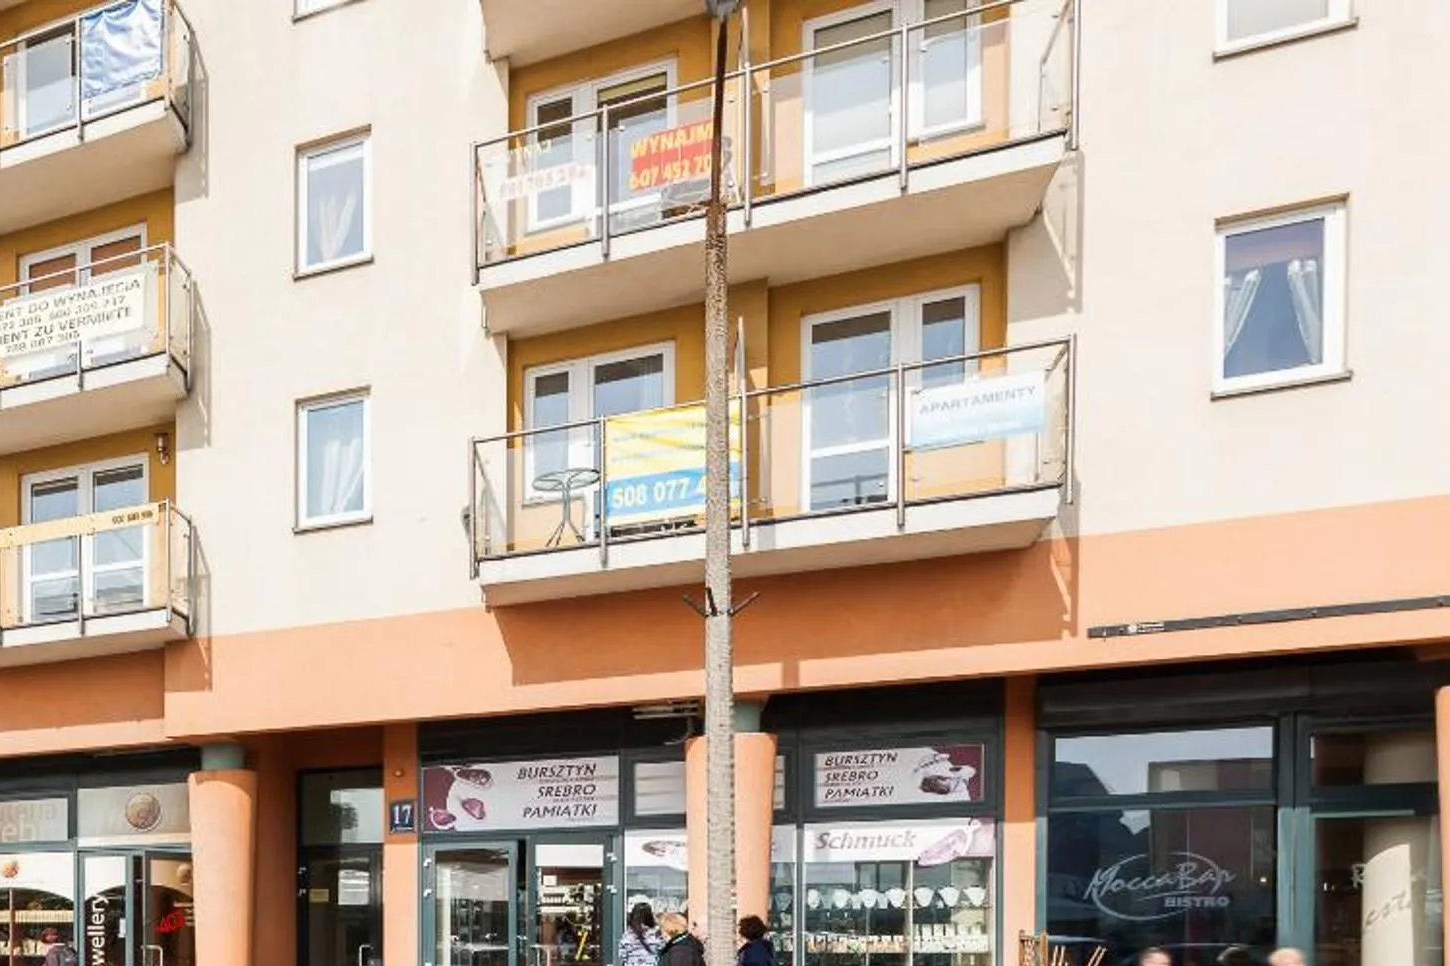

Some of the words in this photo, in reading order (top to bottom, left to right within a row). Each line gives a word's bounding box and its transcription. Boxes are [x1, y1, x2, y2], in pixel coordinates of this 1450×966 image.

[28, 299, 49, 315] DO
[33, 323, 53, 338] ZU
[919, 385, 1036, 415] APARTAMENTY
[653, 476, 691, 502] 077
[825, 752, 898, 767] BURSZTYN
[517, 763, 597, 780] BURSZTYN
[824, 770, 879, 784] SREBRO
[537, 783, 597, 799] SREBRO
[393, 803, 412, 825] 17
[815, 828, 917, 851] Schmuck
[1163, 896, 1231, 908] BISTRO
